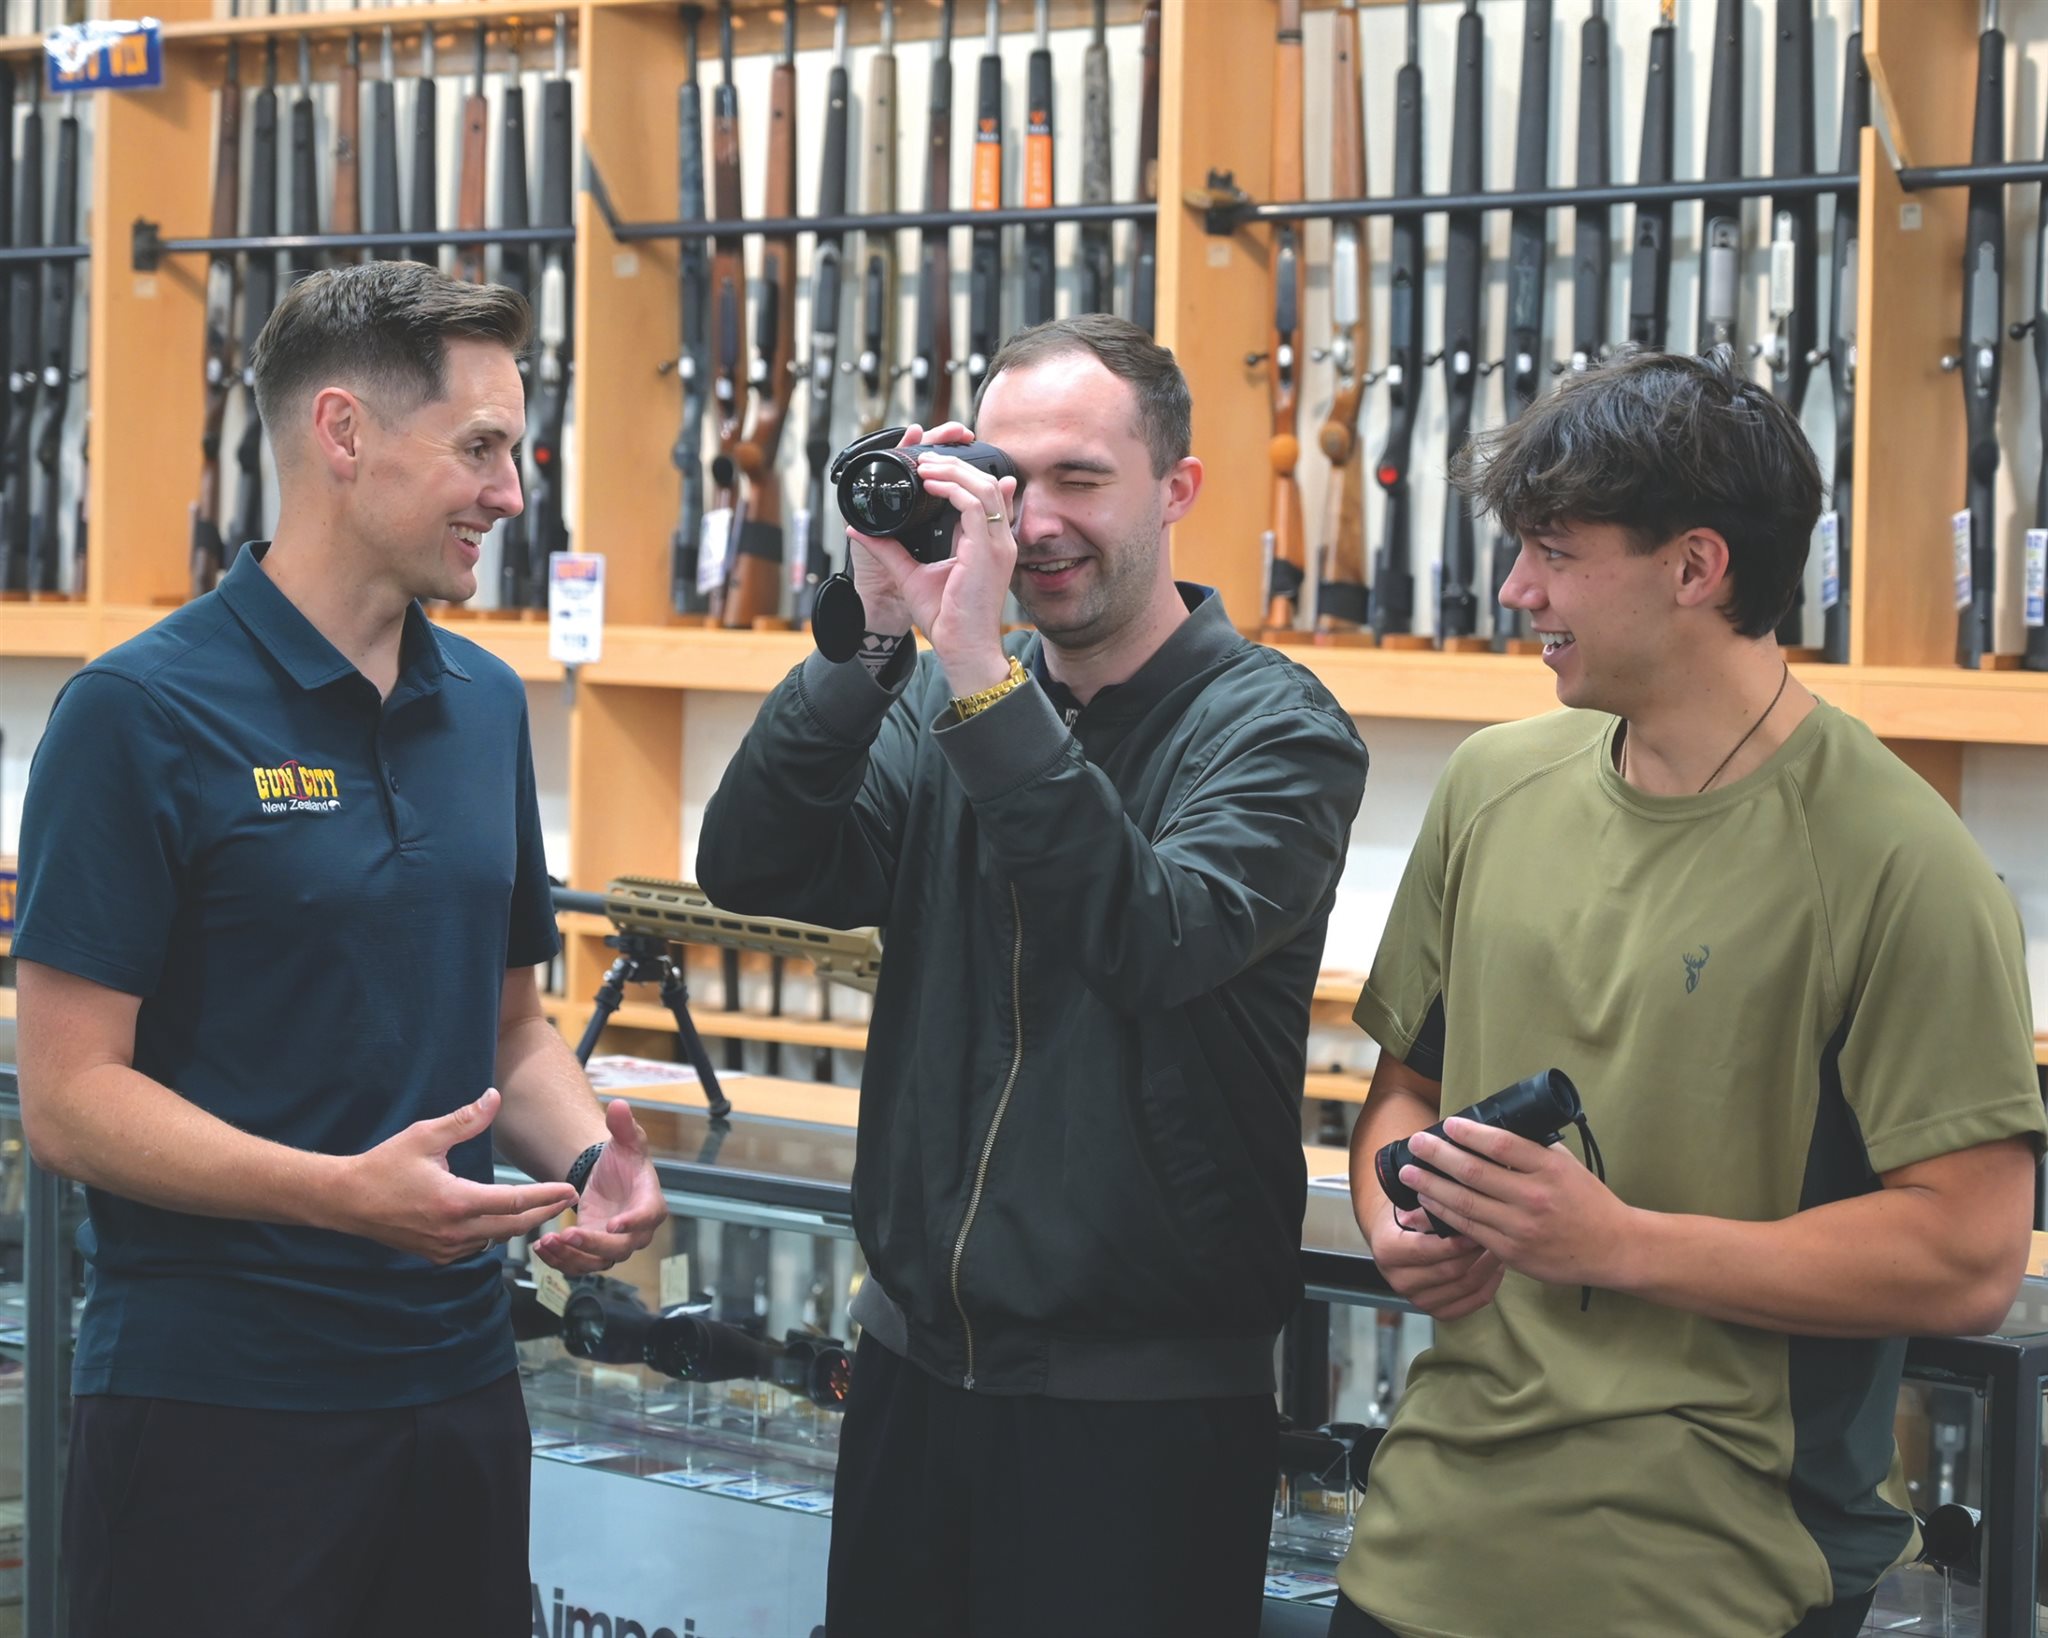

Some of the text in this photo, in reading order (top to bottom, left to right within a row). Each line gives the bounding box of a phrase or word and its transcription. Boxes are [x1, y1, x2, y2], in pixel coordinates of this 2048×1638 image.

[253, 766, 338, 800] GUN CITY
[262, 799, 328, 813] New Zealand
